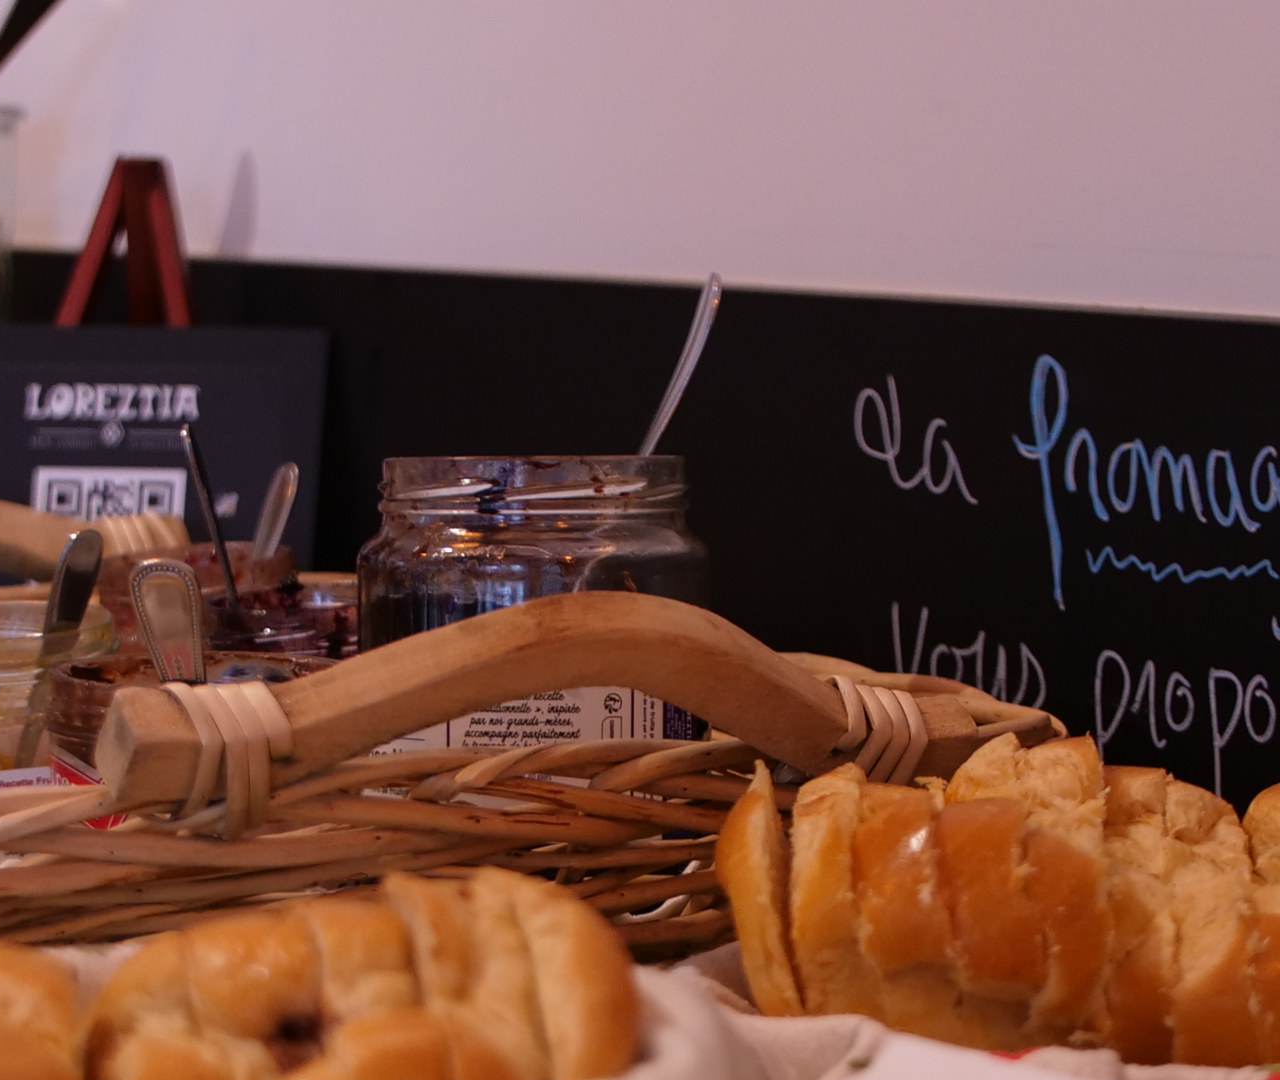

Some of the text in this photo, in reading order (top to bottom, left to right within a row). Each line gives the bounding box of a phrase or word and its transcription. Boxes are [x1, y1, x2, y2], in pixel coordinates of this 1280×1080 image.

[24, 381, 201, 421] LOREZTIA
[547, 703, 582, 716] inspirée
[469, 717, 486, 728] par
[488, 718, 504, 726] nos
[464, 729, 519, 743] accompagne
[521, 728, 581, 743] parfaitement
